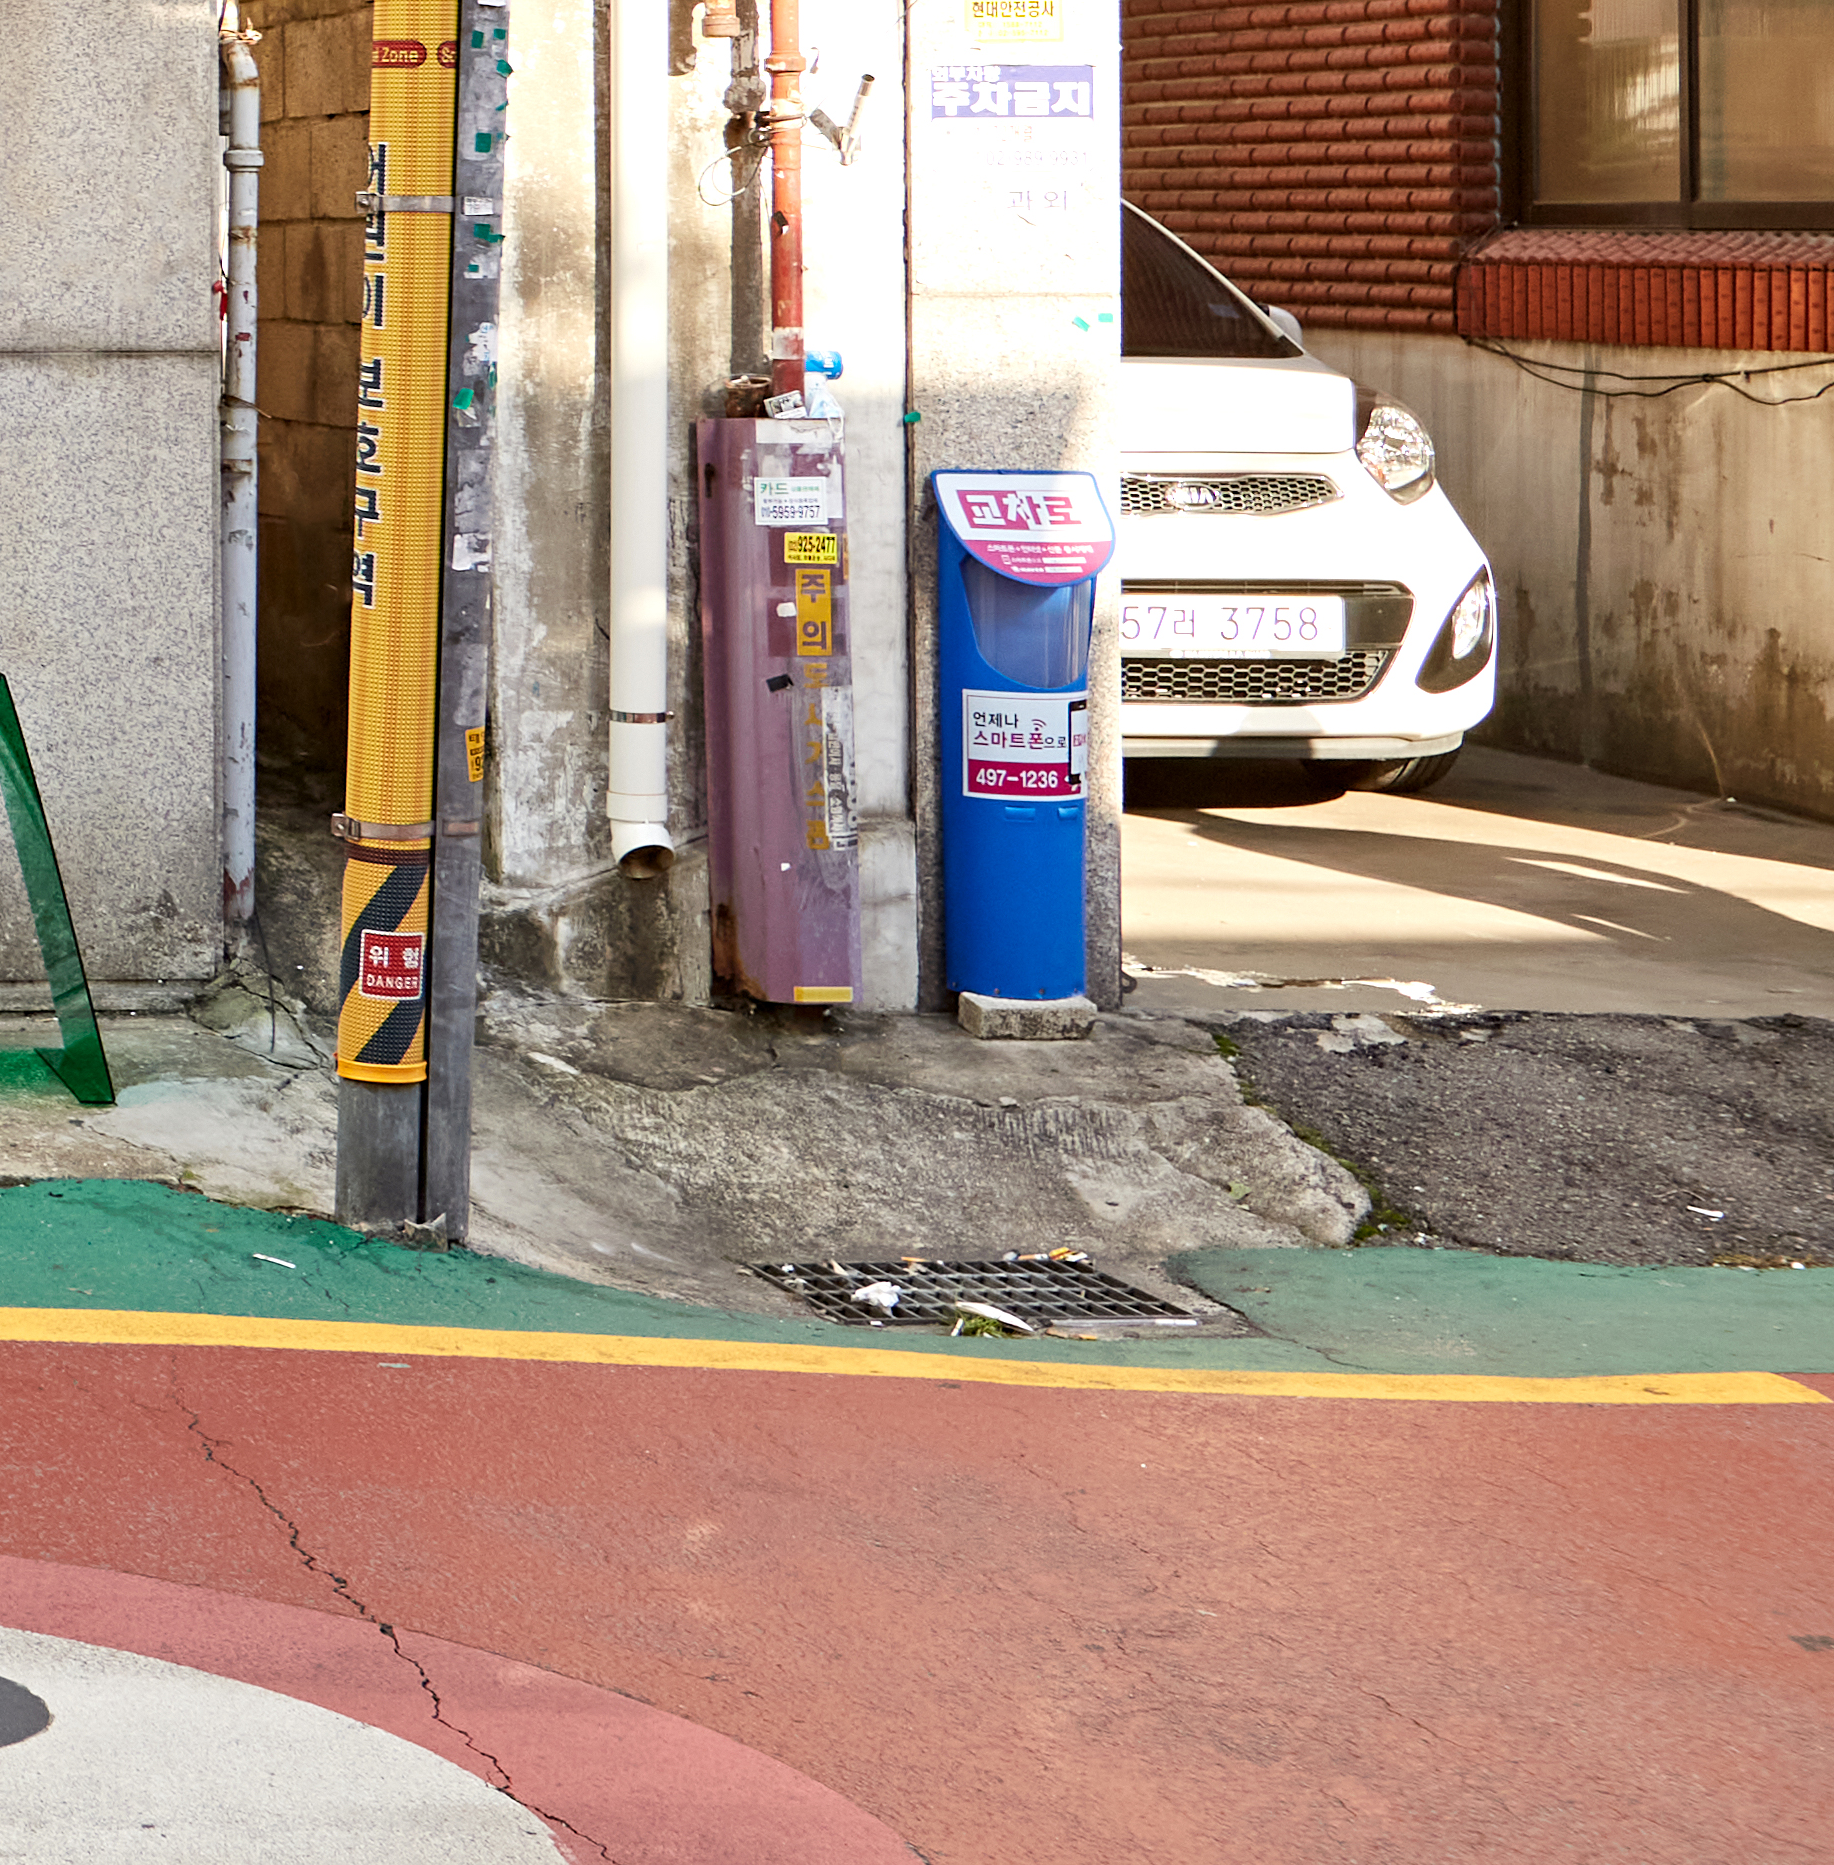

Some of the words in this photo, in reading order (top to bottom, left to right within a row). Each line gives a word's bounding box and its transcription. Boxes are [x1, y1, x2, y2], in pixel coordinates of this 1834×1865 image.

[971, 0, 1055, 18] 현대안전공사
[932, 80, 1091, 117] 주차금지
[760, 482, 789, 496] 카드
[1220, 606, 1319, 641] 3758
[973, 711, 1019, 728] 언제나
[973, 730, 1067, 750] 스마트폰으로
[976, 768, 1059, 789] 497-1236
[366, 973, 420, 990] DANGER
